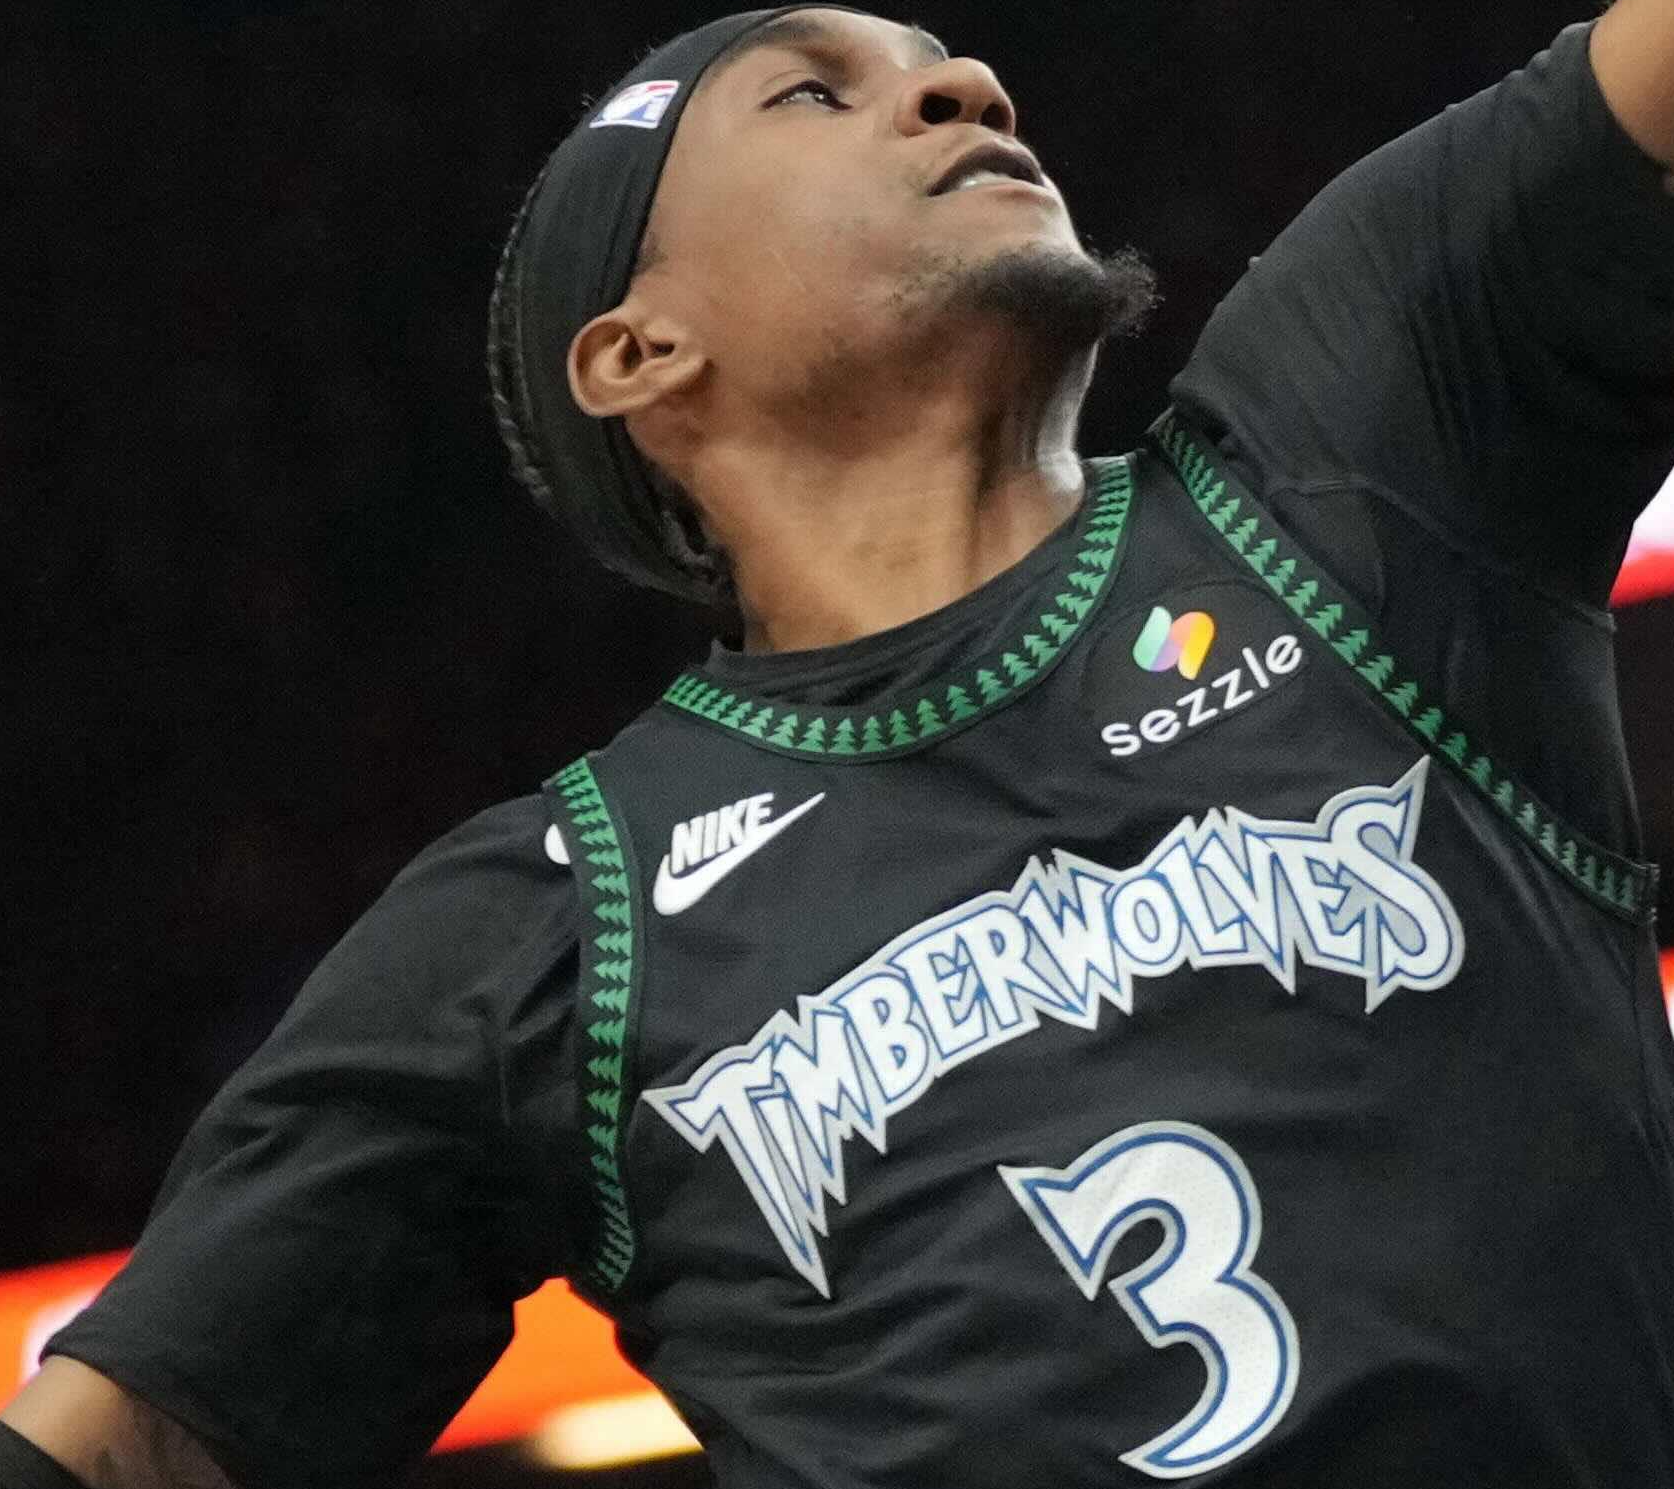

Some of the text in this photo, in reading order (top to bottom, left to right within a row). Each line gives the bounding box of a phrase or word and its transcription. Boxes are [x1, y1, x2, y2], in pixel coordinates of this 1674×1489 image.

[1100, 634, 1303, 757] sezzle
[671, 792, 775, 875] NIKE
[640, 755, 1465, 1300] TIMBERWOLVES
[997, 1120, 1301, 1480] 3
